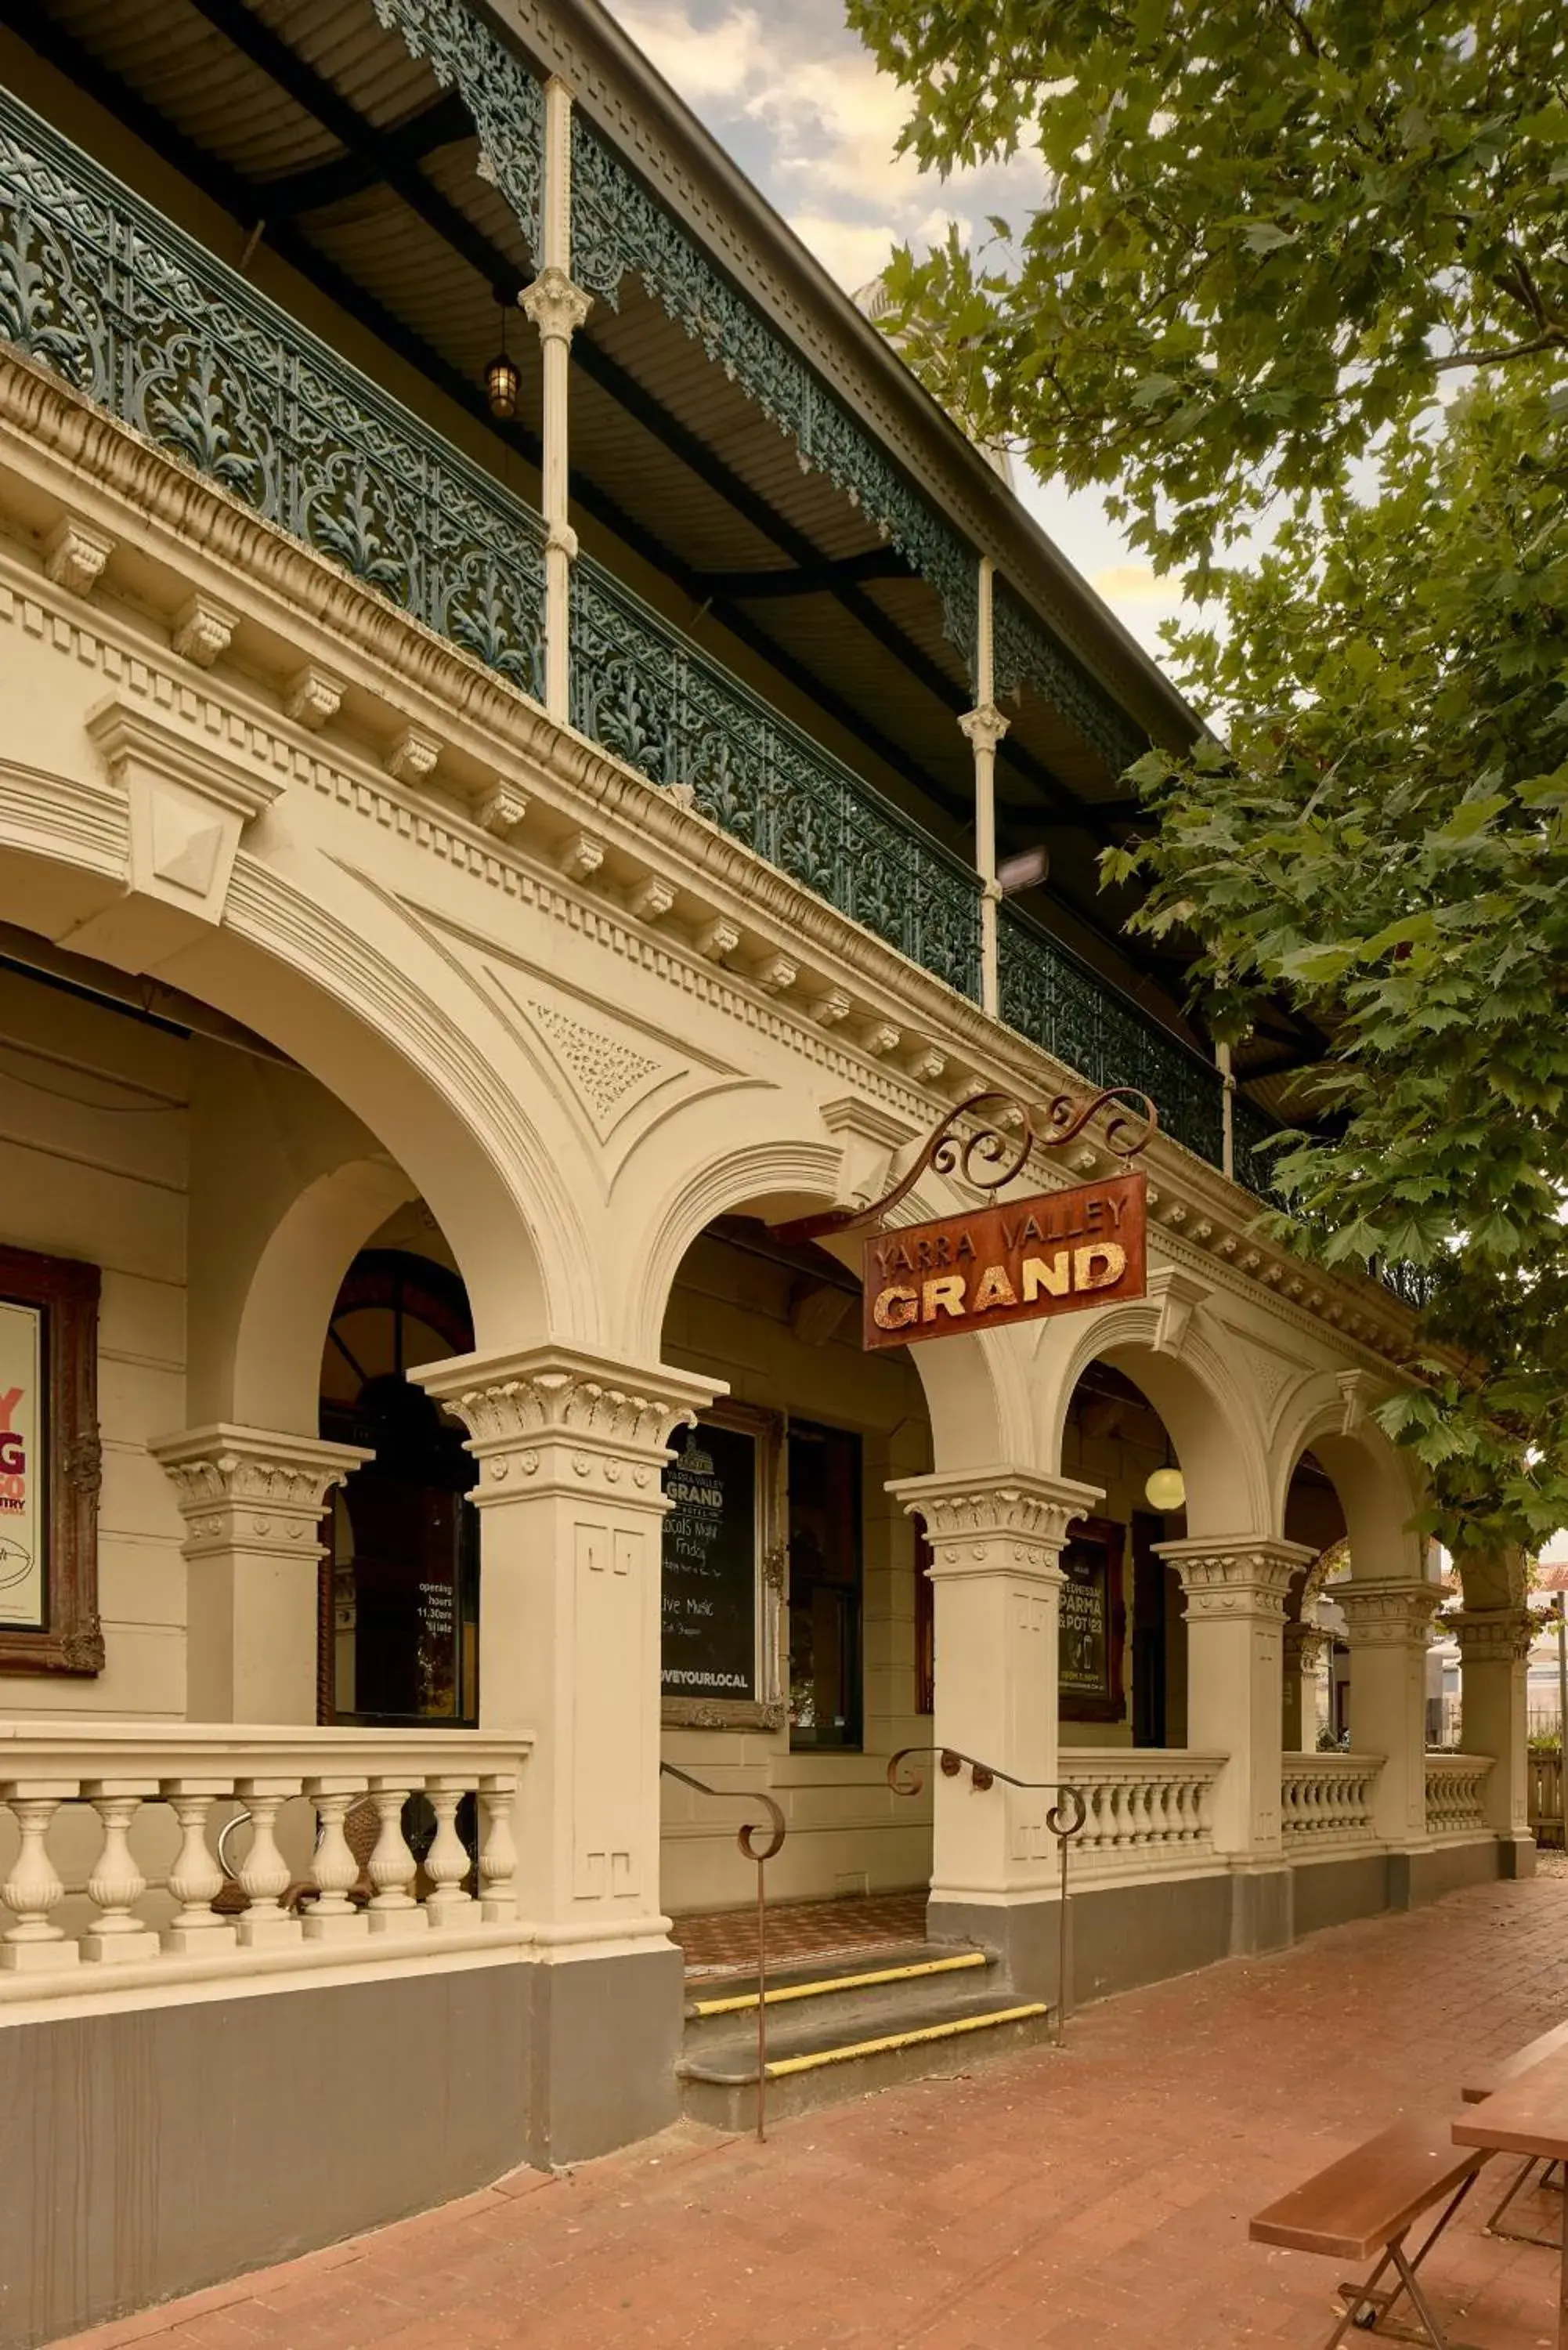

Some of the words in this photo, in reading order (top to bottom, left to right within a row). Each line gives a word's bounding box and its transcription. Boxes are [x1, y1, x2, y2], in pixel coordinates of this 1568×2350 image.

[875, 1230, 977, 1279] YARRA
[1002, 1195, 1128, 1249] VALLEY
[873, 1242, 1126, 1329] GRAND
[667, 1480, 723, 1508] GRAND
[428, 1594, 453, 1607] hours
[687, 1597, 714, 1617] Music
[1059, 1593, 1102, 1617] PARMA
